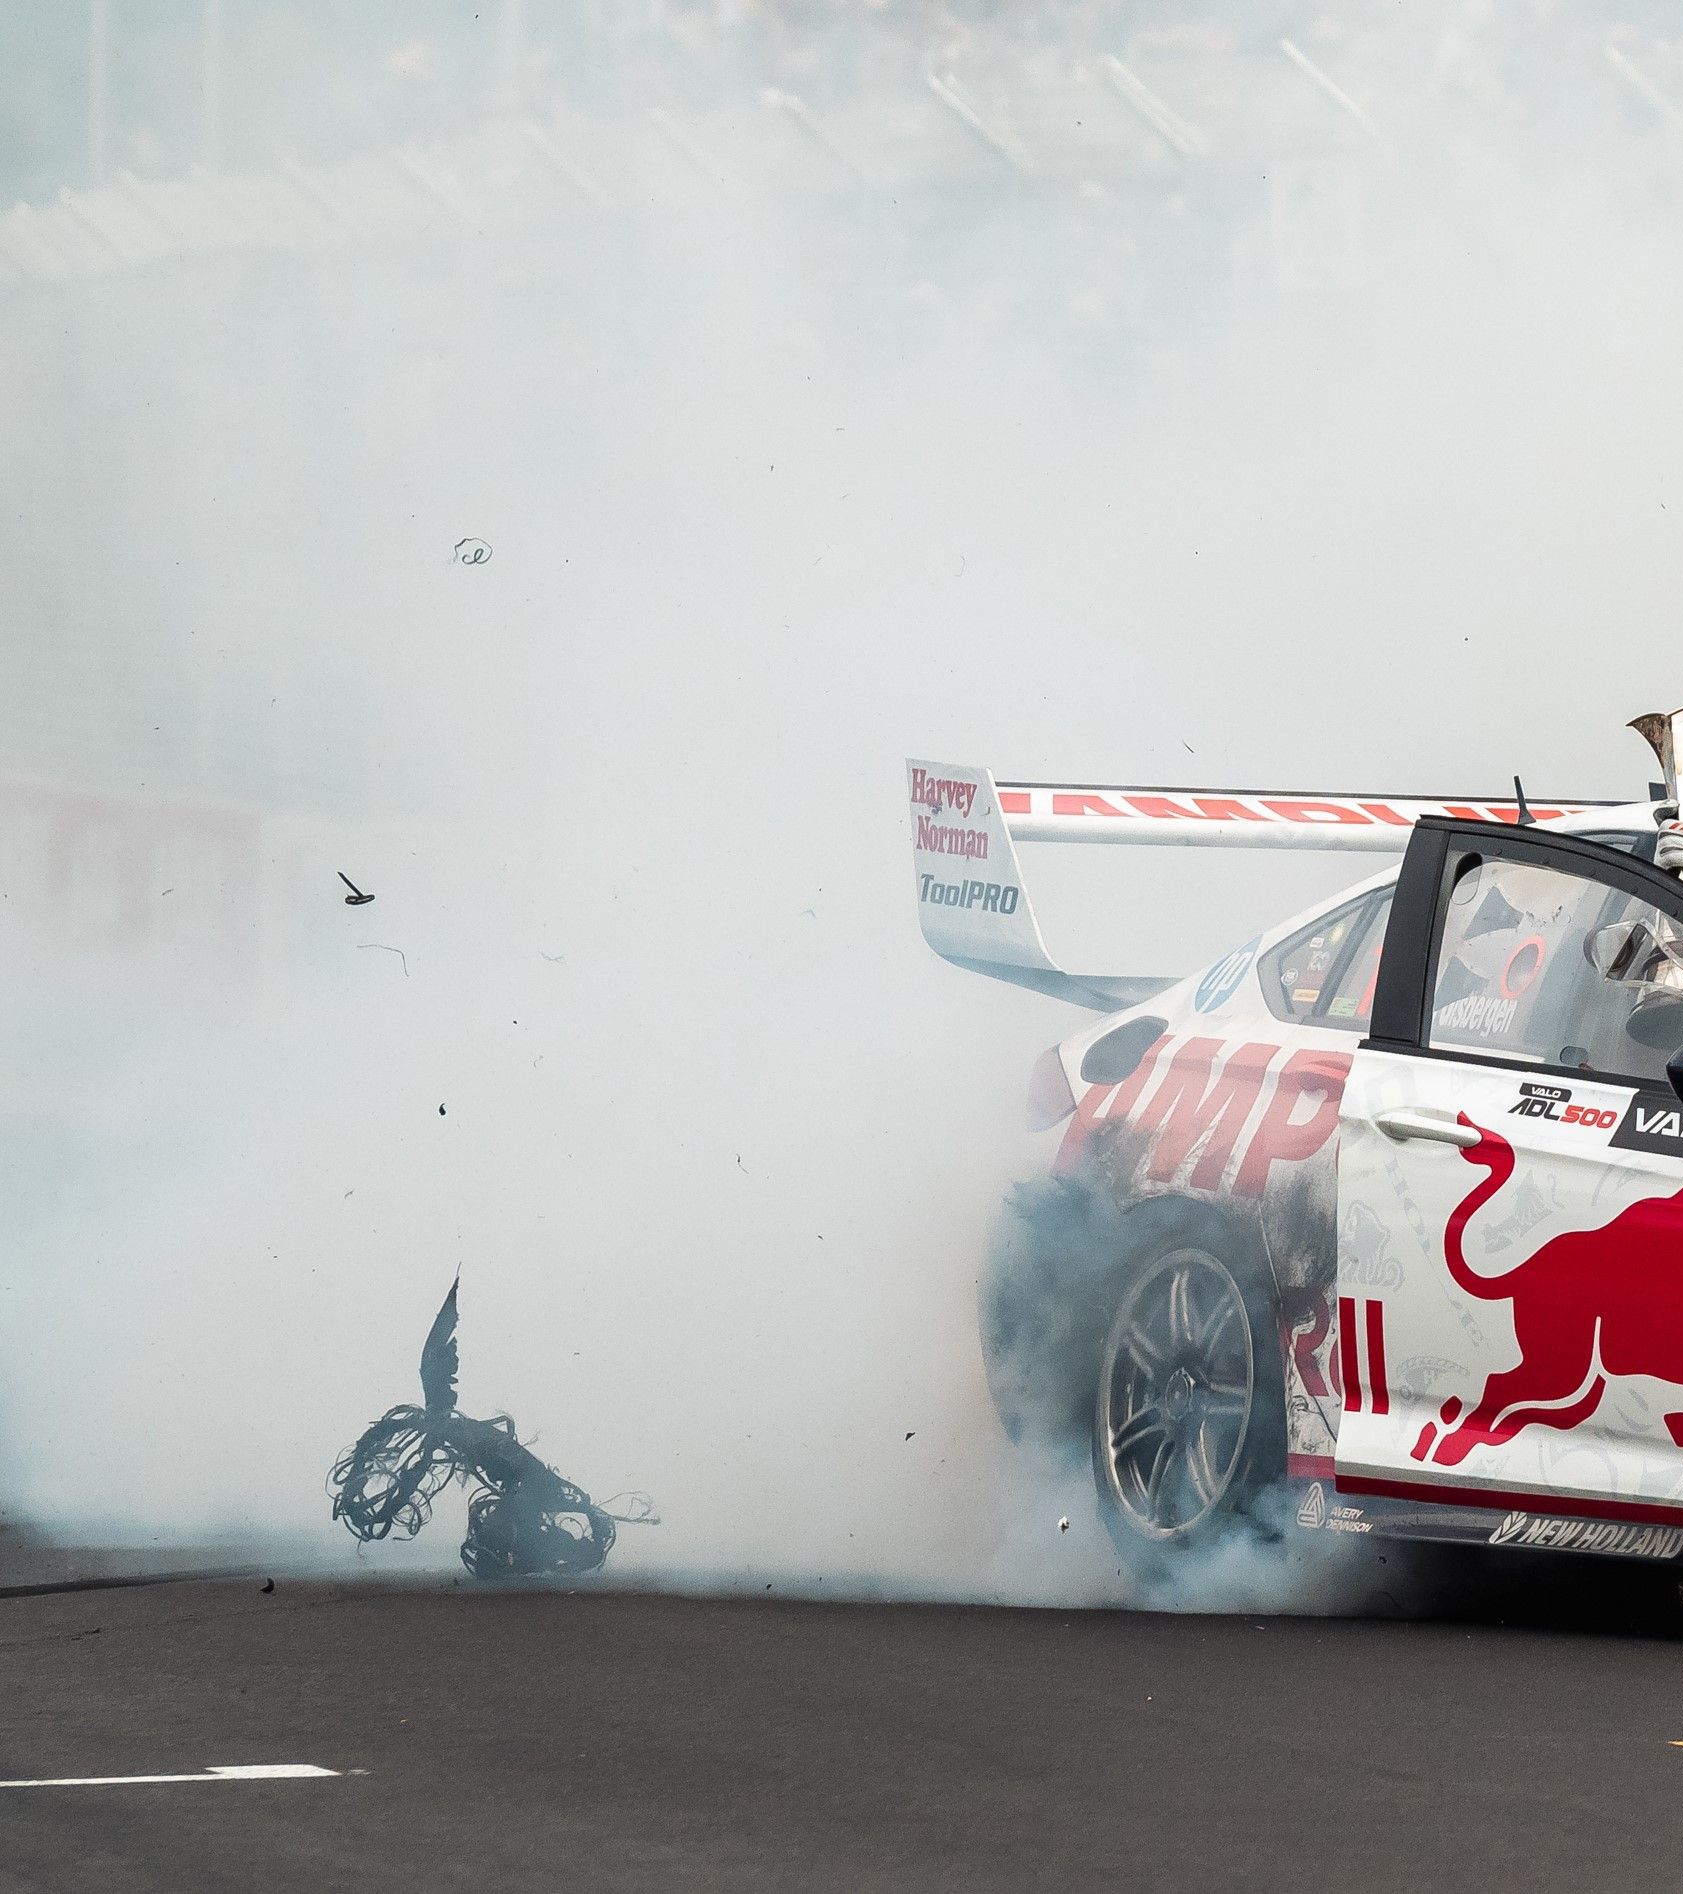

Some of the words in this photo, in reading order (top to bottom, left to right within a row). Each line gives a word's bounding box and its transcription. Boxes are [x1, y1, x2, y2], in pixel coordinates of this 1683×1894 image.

[911, 768, 978, 818] Harvey
[916, 815, 989, 860] Norman
[921, 873, 1019, 914] ToolPRO
[1201, 945, 1254, 1014] hp
[1530, 1085, 1562, 1098] VALO
[1053, 1034, 1354, 1197] AMP
[1507, 1098, 1617, 1129] ADL500
[1325, 1518, 1374, 1533] DENNISON
[1330, 1506, 1364, 1520] AVERY
[1522, 1518, 1583, 1549] NEW
